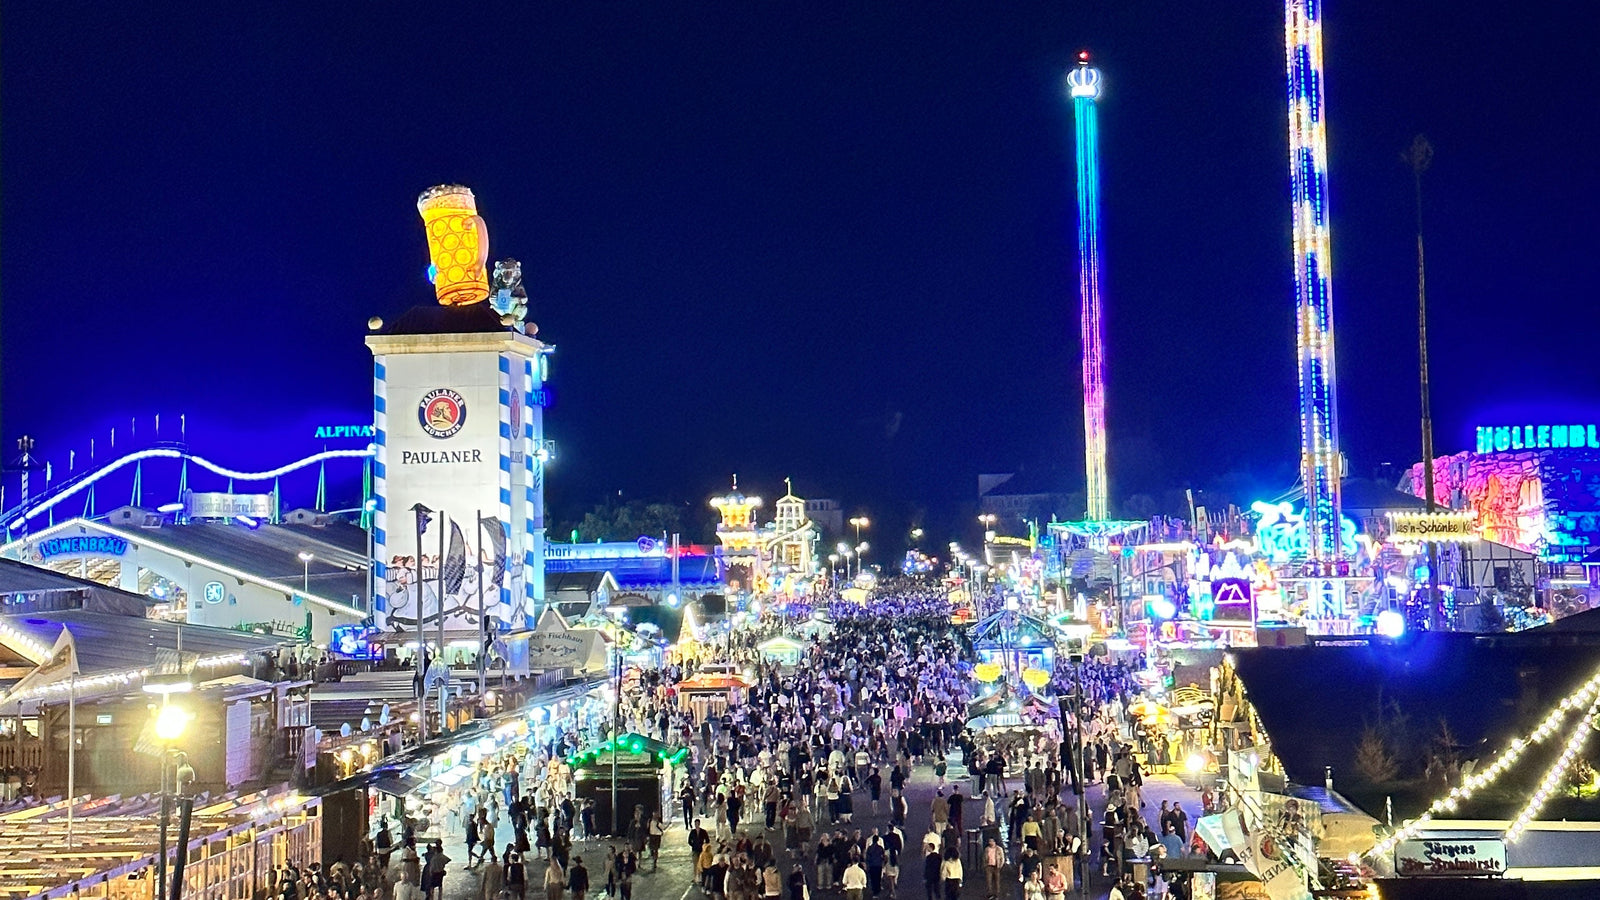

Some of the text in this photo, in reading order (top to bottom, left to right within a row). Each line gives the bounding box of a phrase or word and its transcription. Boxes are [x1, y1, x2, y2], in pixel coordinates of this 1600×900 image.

[420, 389, 465, 409] PAULANER
[423, 424, 462, 438] MÜNCHEN
[402, 449, 482, 464] PAULANER
[40, 537, 127, 559] LÖWENBRÄU
[548, 632, 583, 643] Fischhaus
[1423, 841, 1476, 861] Jürgens
